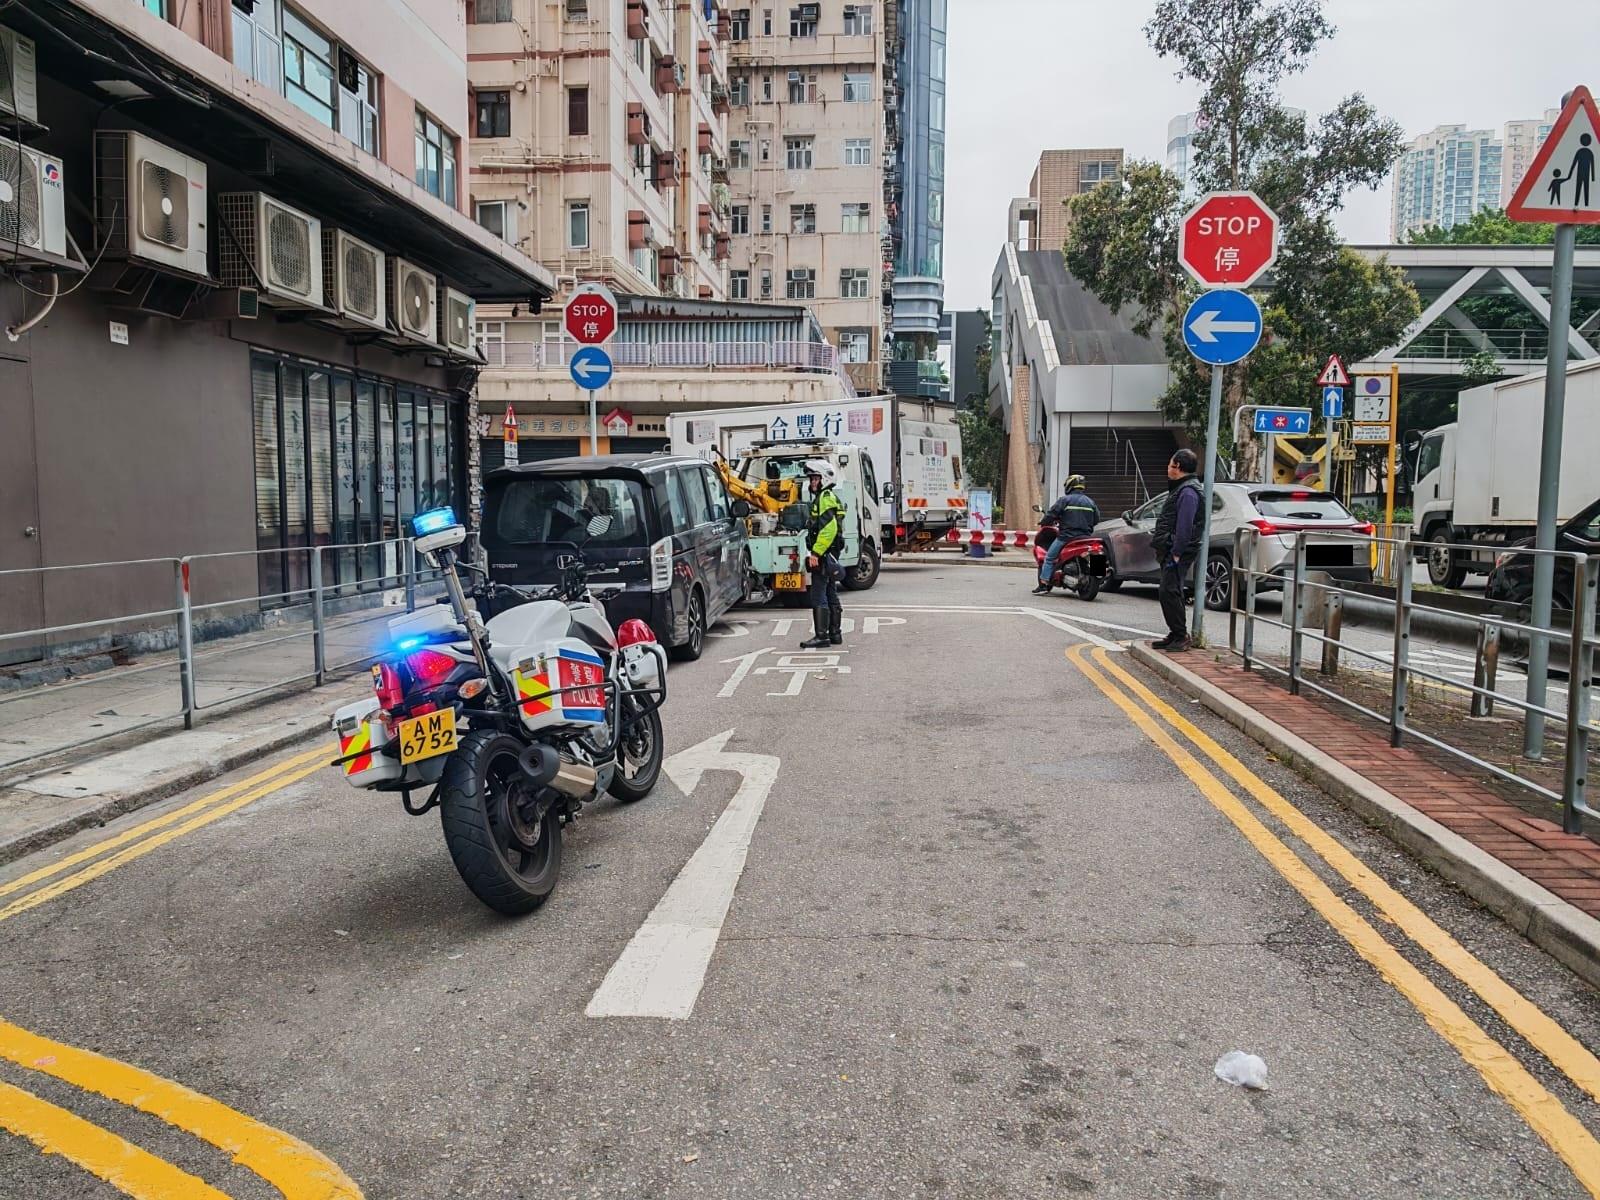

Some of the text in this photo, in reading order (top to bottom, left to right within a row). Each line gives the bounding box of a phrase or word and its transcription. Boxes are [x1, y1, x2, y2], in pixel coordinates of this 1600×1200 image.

[43, 177, 61, 189] GREE
[1198, 216, 1261, 236] STOP
[1214, 246, 1240, 272] 停
[572, 305, 607, 317] STOP
[582, 321, 600, 338] 停
[1378, 398, 1384, 407] 7
[1377, 411, 1383, 419] 7
[770, 413, 843, 440] 合豐行
[780, 580, 797, 588] 900
[715, 647, 852, 698] 停
[402, 730, 453, 757] 6752
